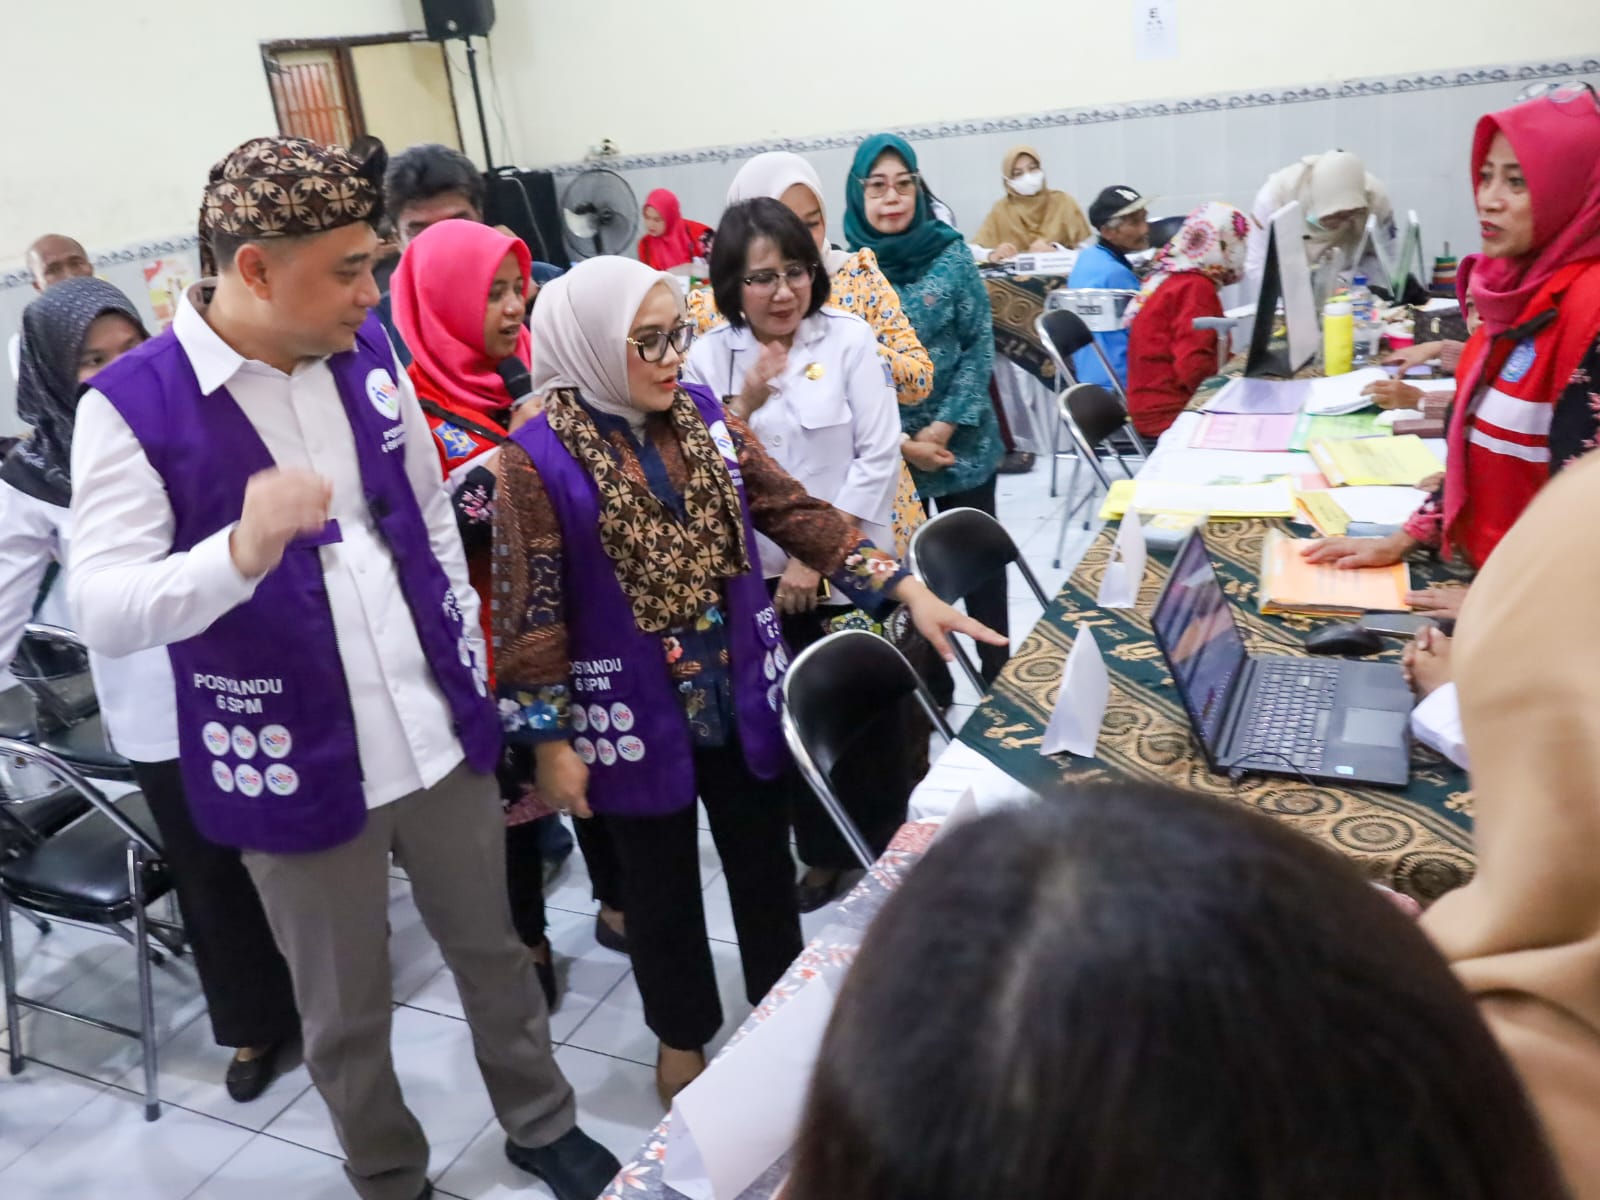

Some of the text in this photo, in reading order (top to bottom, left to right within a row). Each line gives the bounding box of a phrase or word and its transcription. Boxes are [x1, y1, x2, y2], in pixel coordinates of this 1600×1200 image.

[194, 673, 282, 694] POSYANDU
[575, 676, 612, 692] 6 SPM
[216, 694, 263, 714] 6 SPM
